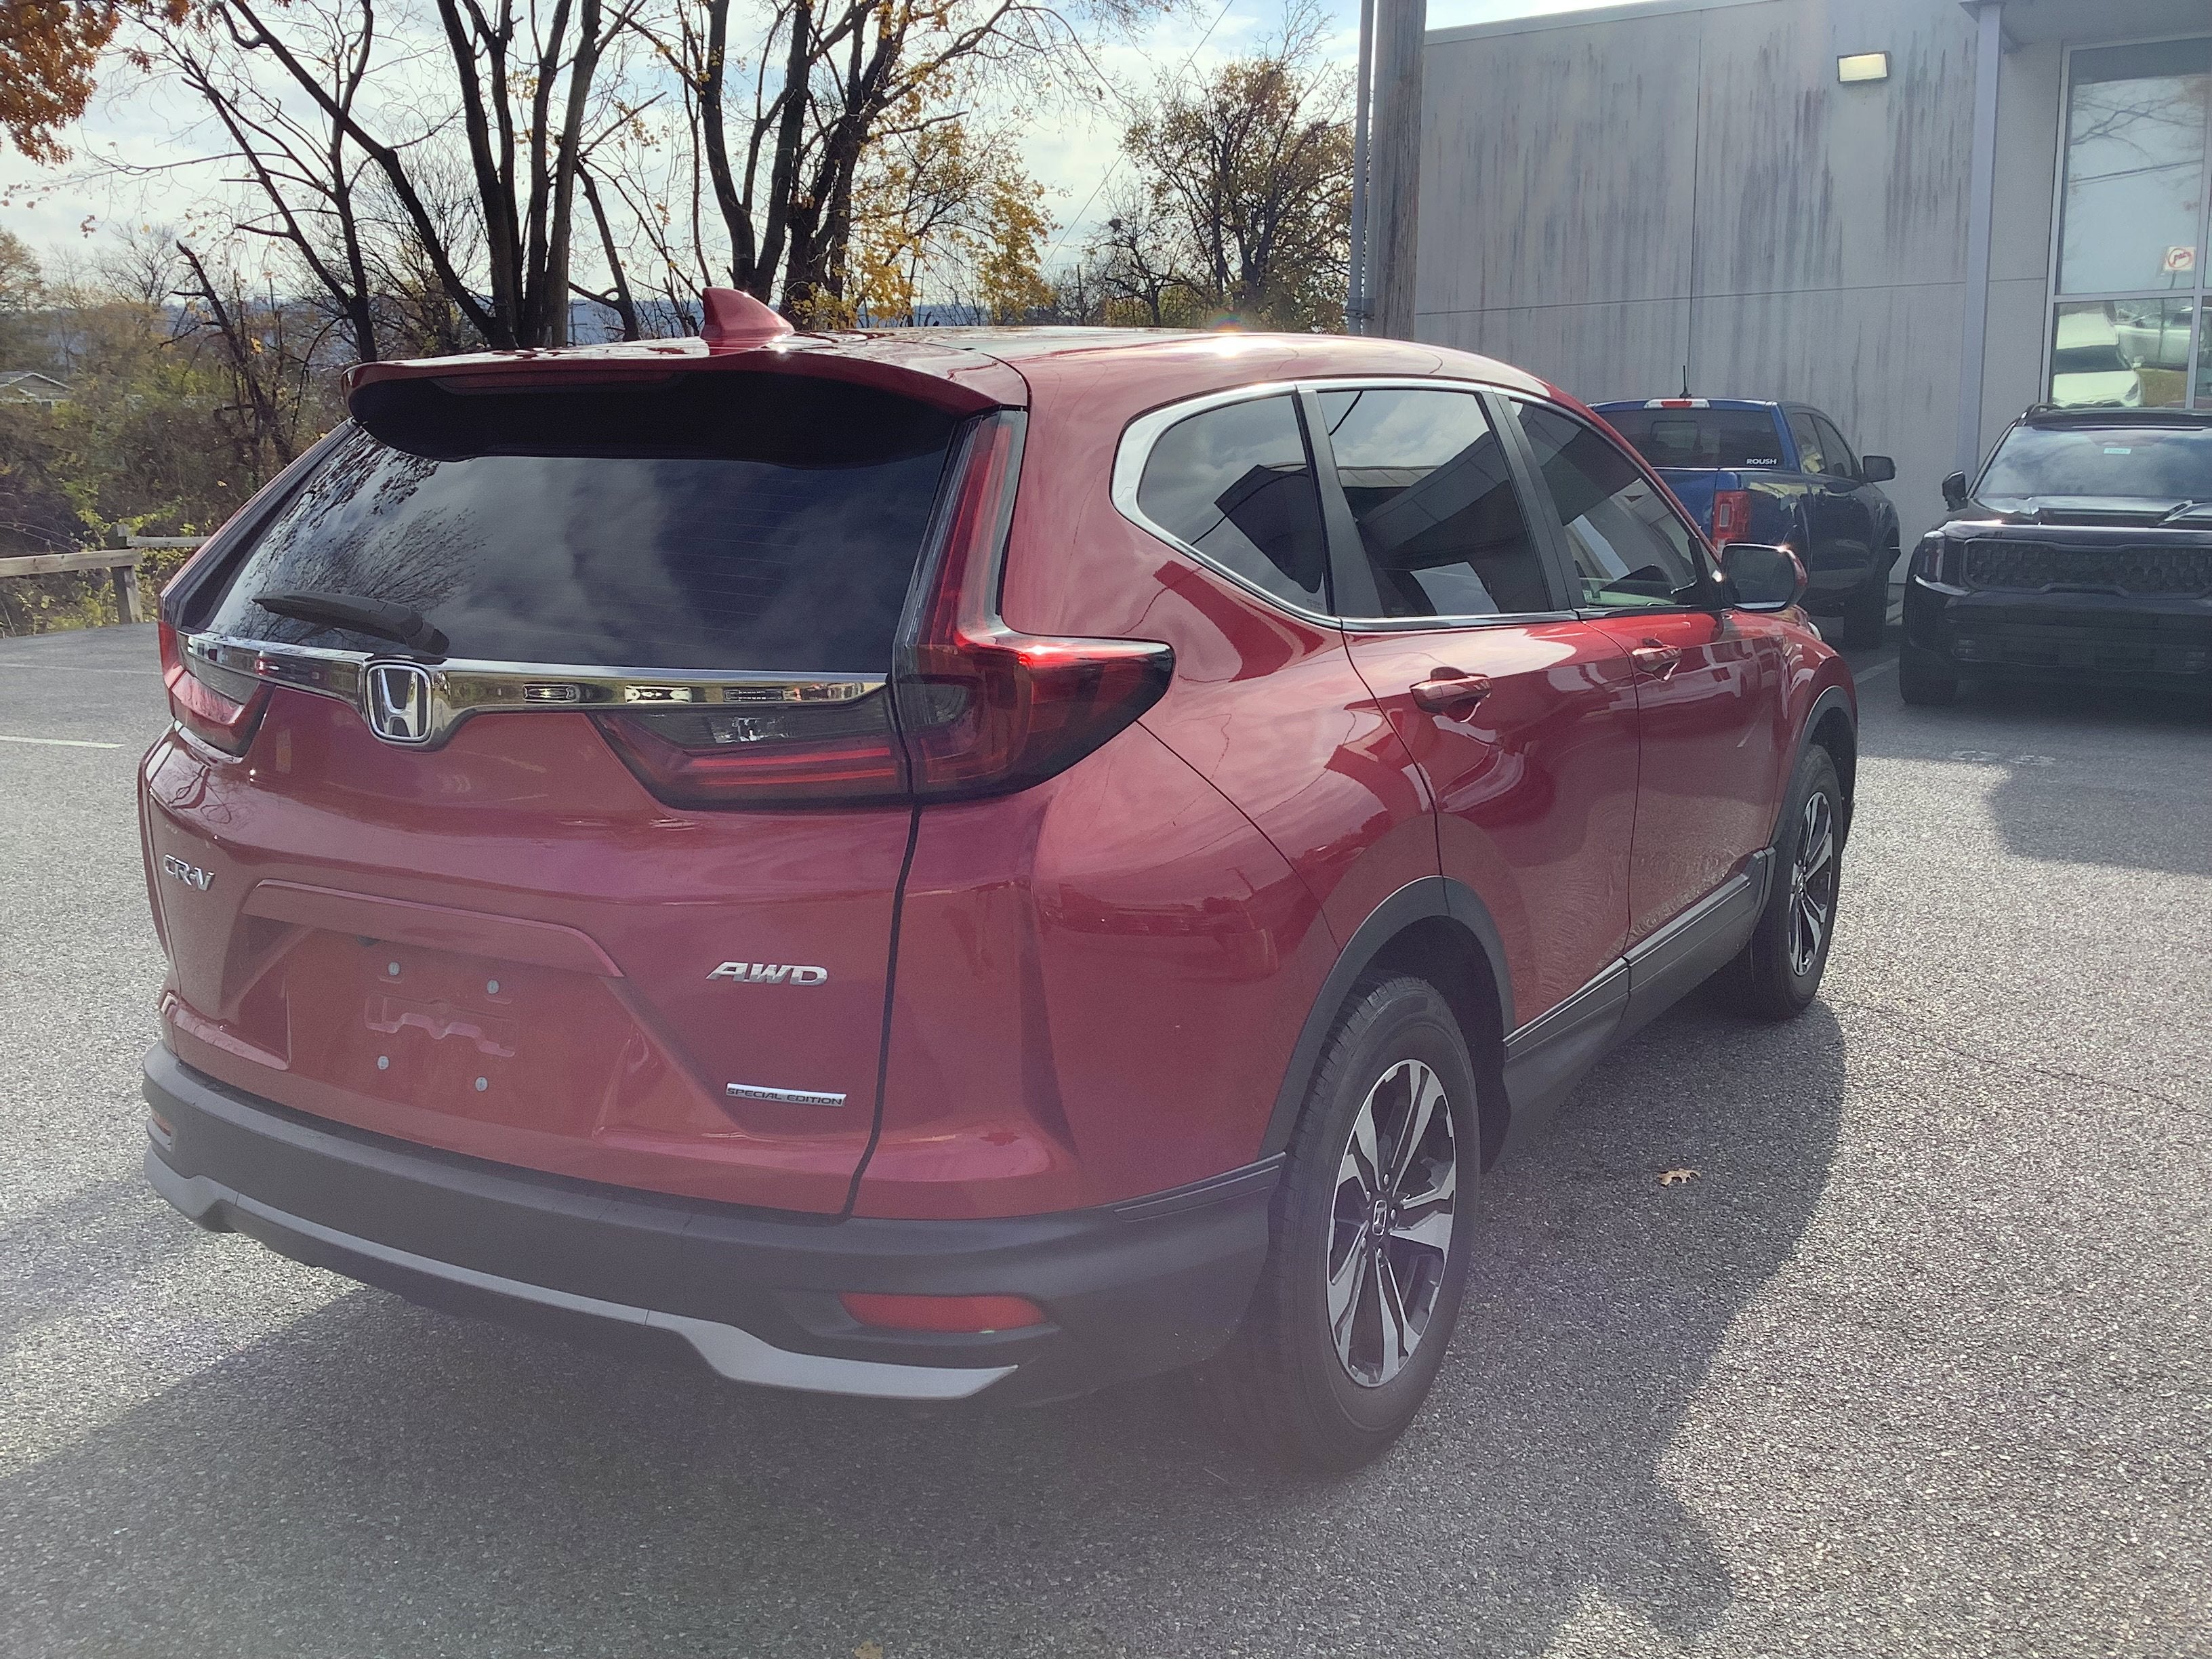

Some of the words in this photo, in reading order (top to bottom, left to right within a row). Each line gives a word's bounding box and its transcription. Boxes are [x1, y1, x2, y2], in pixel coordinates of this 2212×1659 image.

[163, 854, 215, 891] CR-V
[705, 961, 828, 986] AWD
[726, 1087, 782, 1101] SPECIAL
[787, 1094, 842, 1105] EDITION
